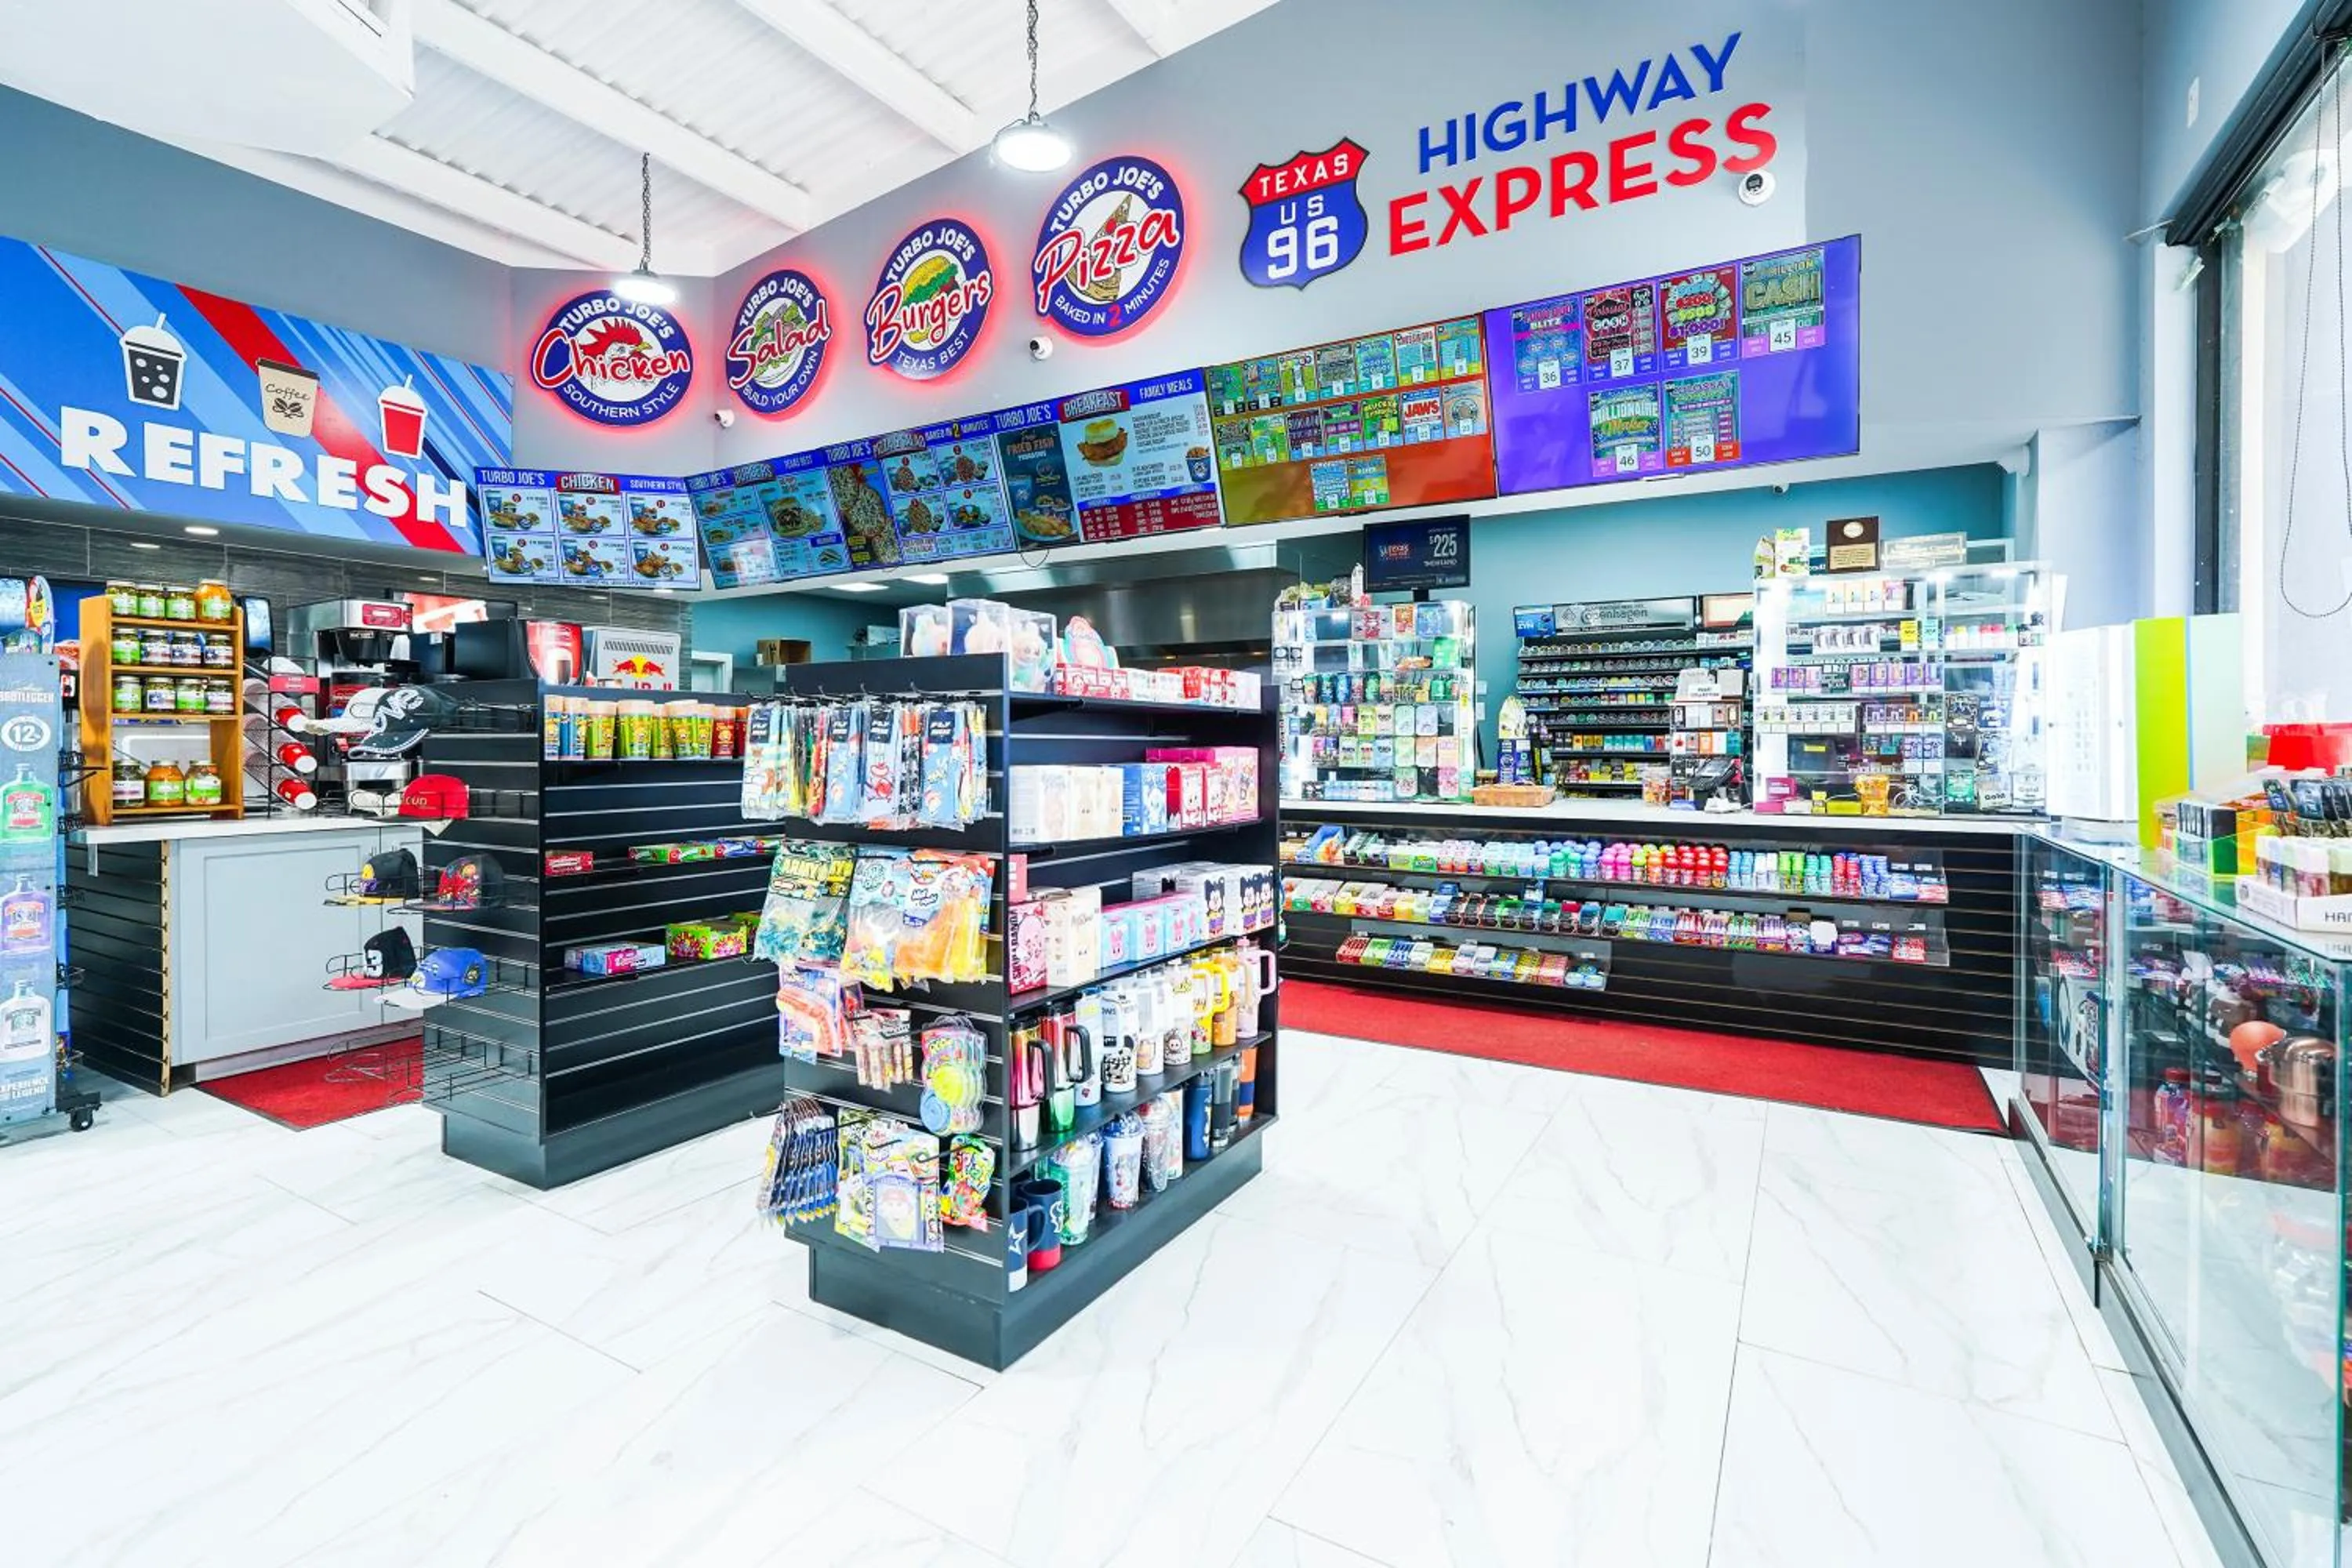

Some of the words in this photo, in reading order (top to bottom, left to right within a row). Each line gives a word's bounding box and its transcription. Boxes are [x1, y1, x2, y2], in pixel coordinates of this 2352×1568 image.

[1417, 31, 1742, 174] HIGHWAY
[1258, 153, 1349, 197] TEXAS
[1388, 103, 1778, 256] EXPRESS
[1050, 171, 1107, 234] TURBO
[1112, 165, 1165, 200] JOE'S
[887, 234, 933, 282] TURBO
[936, 227, 976, 262] JOE'S
[1035, 208, 1179, 314] Pizza
[1267, 215, 1339, 280] 96
[739, 280, 778, 327] TURBO
[780, 277, 813, 308] JOE'S
[1054, 295, 1091, 324] BAKED
[1092, 311, 1105, 325] IN
[1108, 306, 1122, 327] 2
[1124, 258, 1170, 314] MINUTES
[559, 296, 621, 332] TURBO
[625, 303, 675, 340] JOE'S
[868, 270, 991, 363] Burgers
[1774, 332, 1791, 343] 45
[534, 326, 690, 388] Chicken
[729, 299, 832, 389] Salad
[896, 350, 936, 371] TEXAS
[939, 329, 970, 364] BEST
[1614, 359, 1629, 371] 37
[1691, 346, 1707, 358] 39
[265, 383, 311, 401] Coffee
[742, 384, 769, 407] BUILD
[771, 384, 800, 407] YOUR
[798, 350, 819, 389] OWN
[1542, 372, 1557, 383] 36
[563, 384, 641, 418] SOUTHERN
[643, 383, 680, 415] STYLE
[994, 409, 1024, 429] TURBO
[1027, 405, 1051, 423] JOE'S
[1139, 384, 1165, 398] FAMILY
[1166, 378, 1192, 393] MEALS
[1404, 400, 1439, 417] JAWS
[953, 423, 960, 439] 2
[1696, 447, 1711, 457] 50
[60, 405, 467, 527] REFRESH
[481, 470, 514, 485] TURBO
[517, 472, 545, 485] JOE'S
[561, 474, 615, 492] CHICKEN
[630, 479, 665, 490] SOUTHERN
[1620, 456, 1634, 467] 46
[1429, 533, 1457, 557] $225
